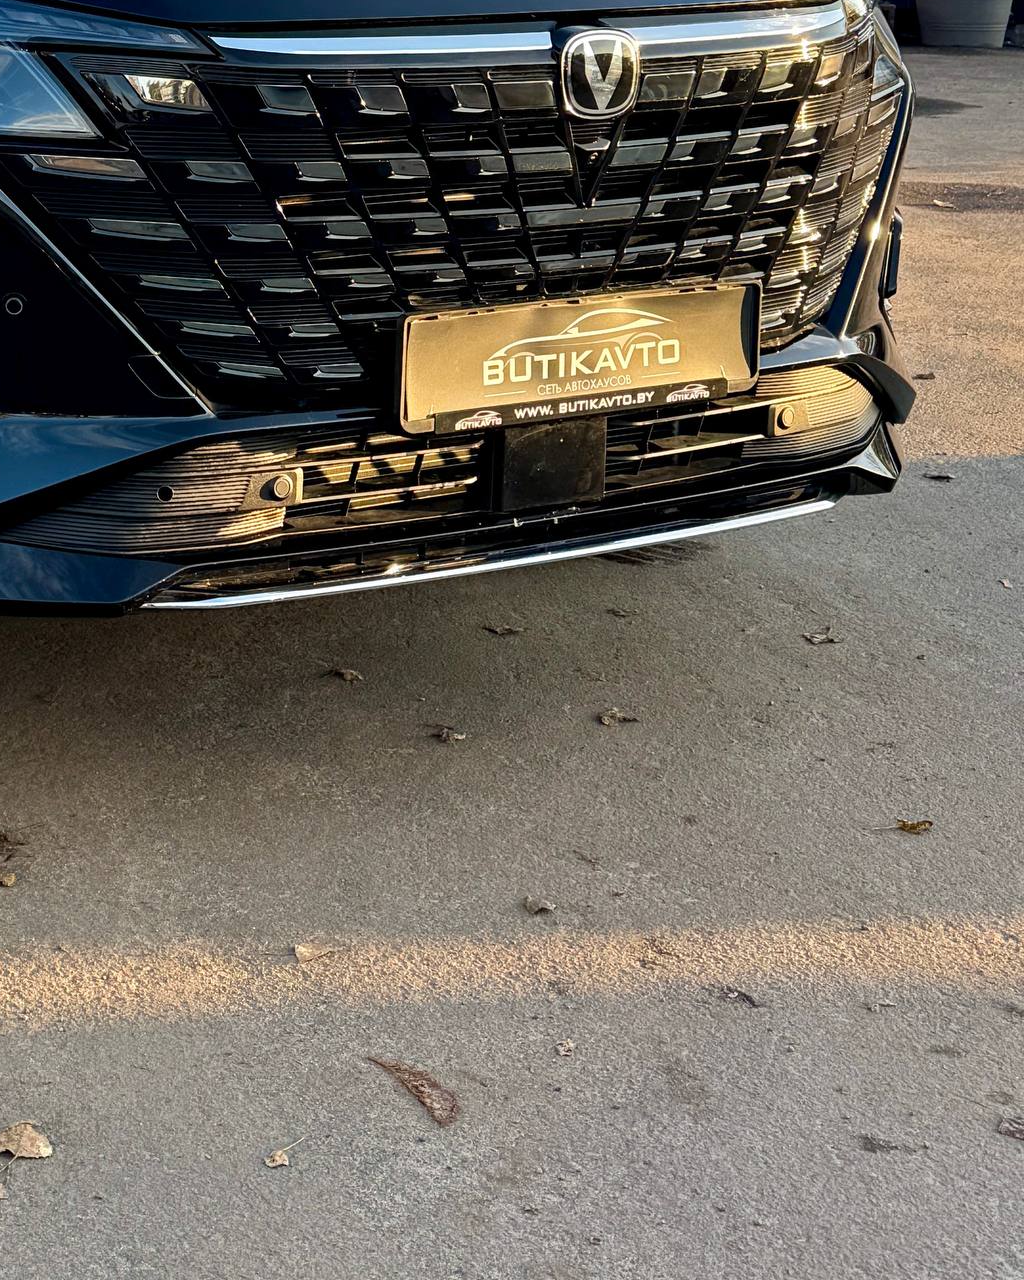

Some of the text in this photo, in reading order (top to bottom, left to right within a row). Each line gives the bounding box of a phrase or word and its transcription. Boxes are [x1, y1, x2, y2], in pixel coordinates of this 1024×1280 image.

[483, 338, 680, 386] BUTIKAVTO
[537, 374, 632, 396] СЕТЬ АВТОХАУСОВ
[666, 389, 710, 403] BUTIKAVTO
[514, 391, 654, 420] WWW. BUTIKAVTO.BY
[455, 416, 502, 431] BUTIKAVTO
